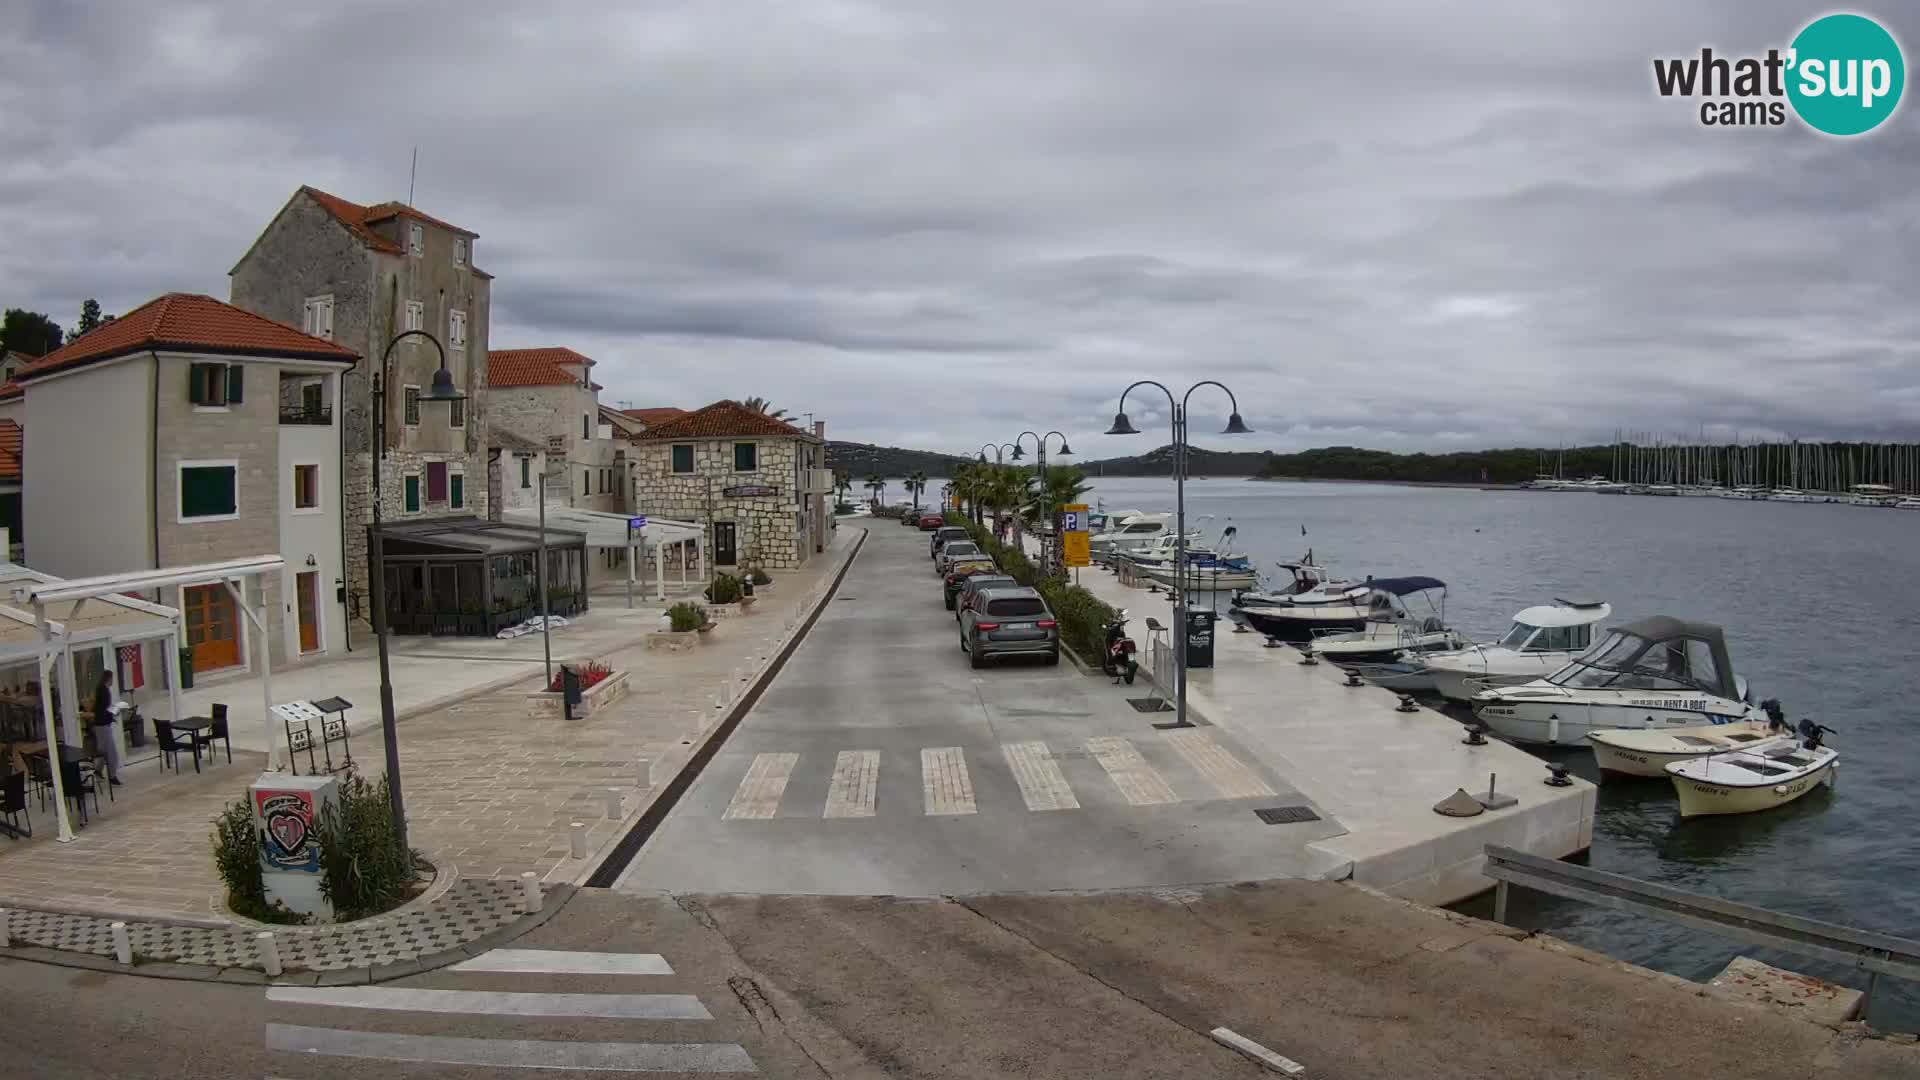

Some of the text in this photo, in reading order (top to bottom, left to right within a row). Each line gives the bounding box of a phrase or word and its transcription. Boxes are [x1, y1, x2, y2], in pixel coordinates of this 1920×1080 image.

[1065, 513, 1076, 529] P
[1663, 699, 1682, 710] RENT
[1682, 700, 1688, 710] A
[1689, 700, 1707, 712] BOAT
